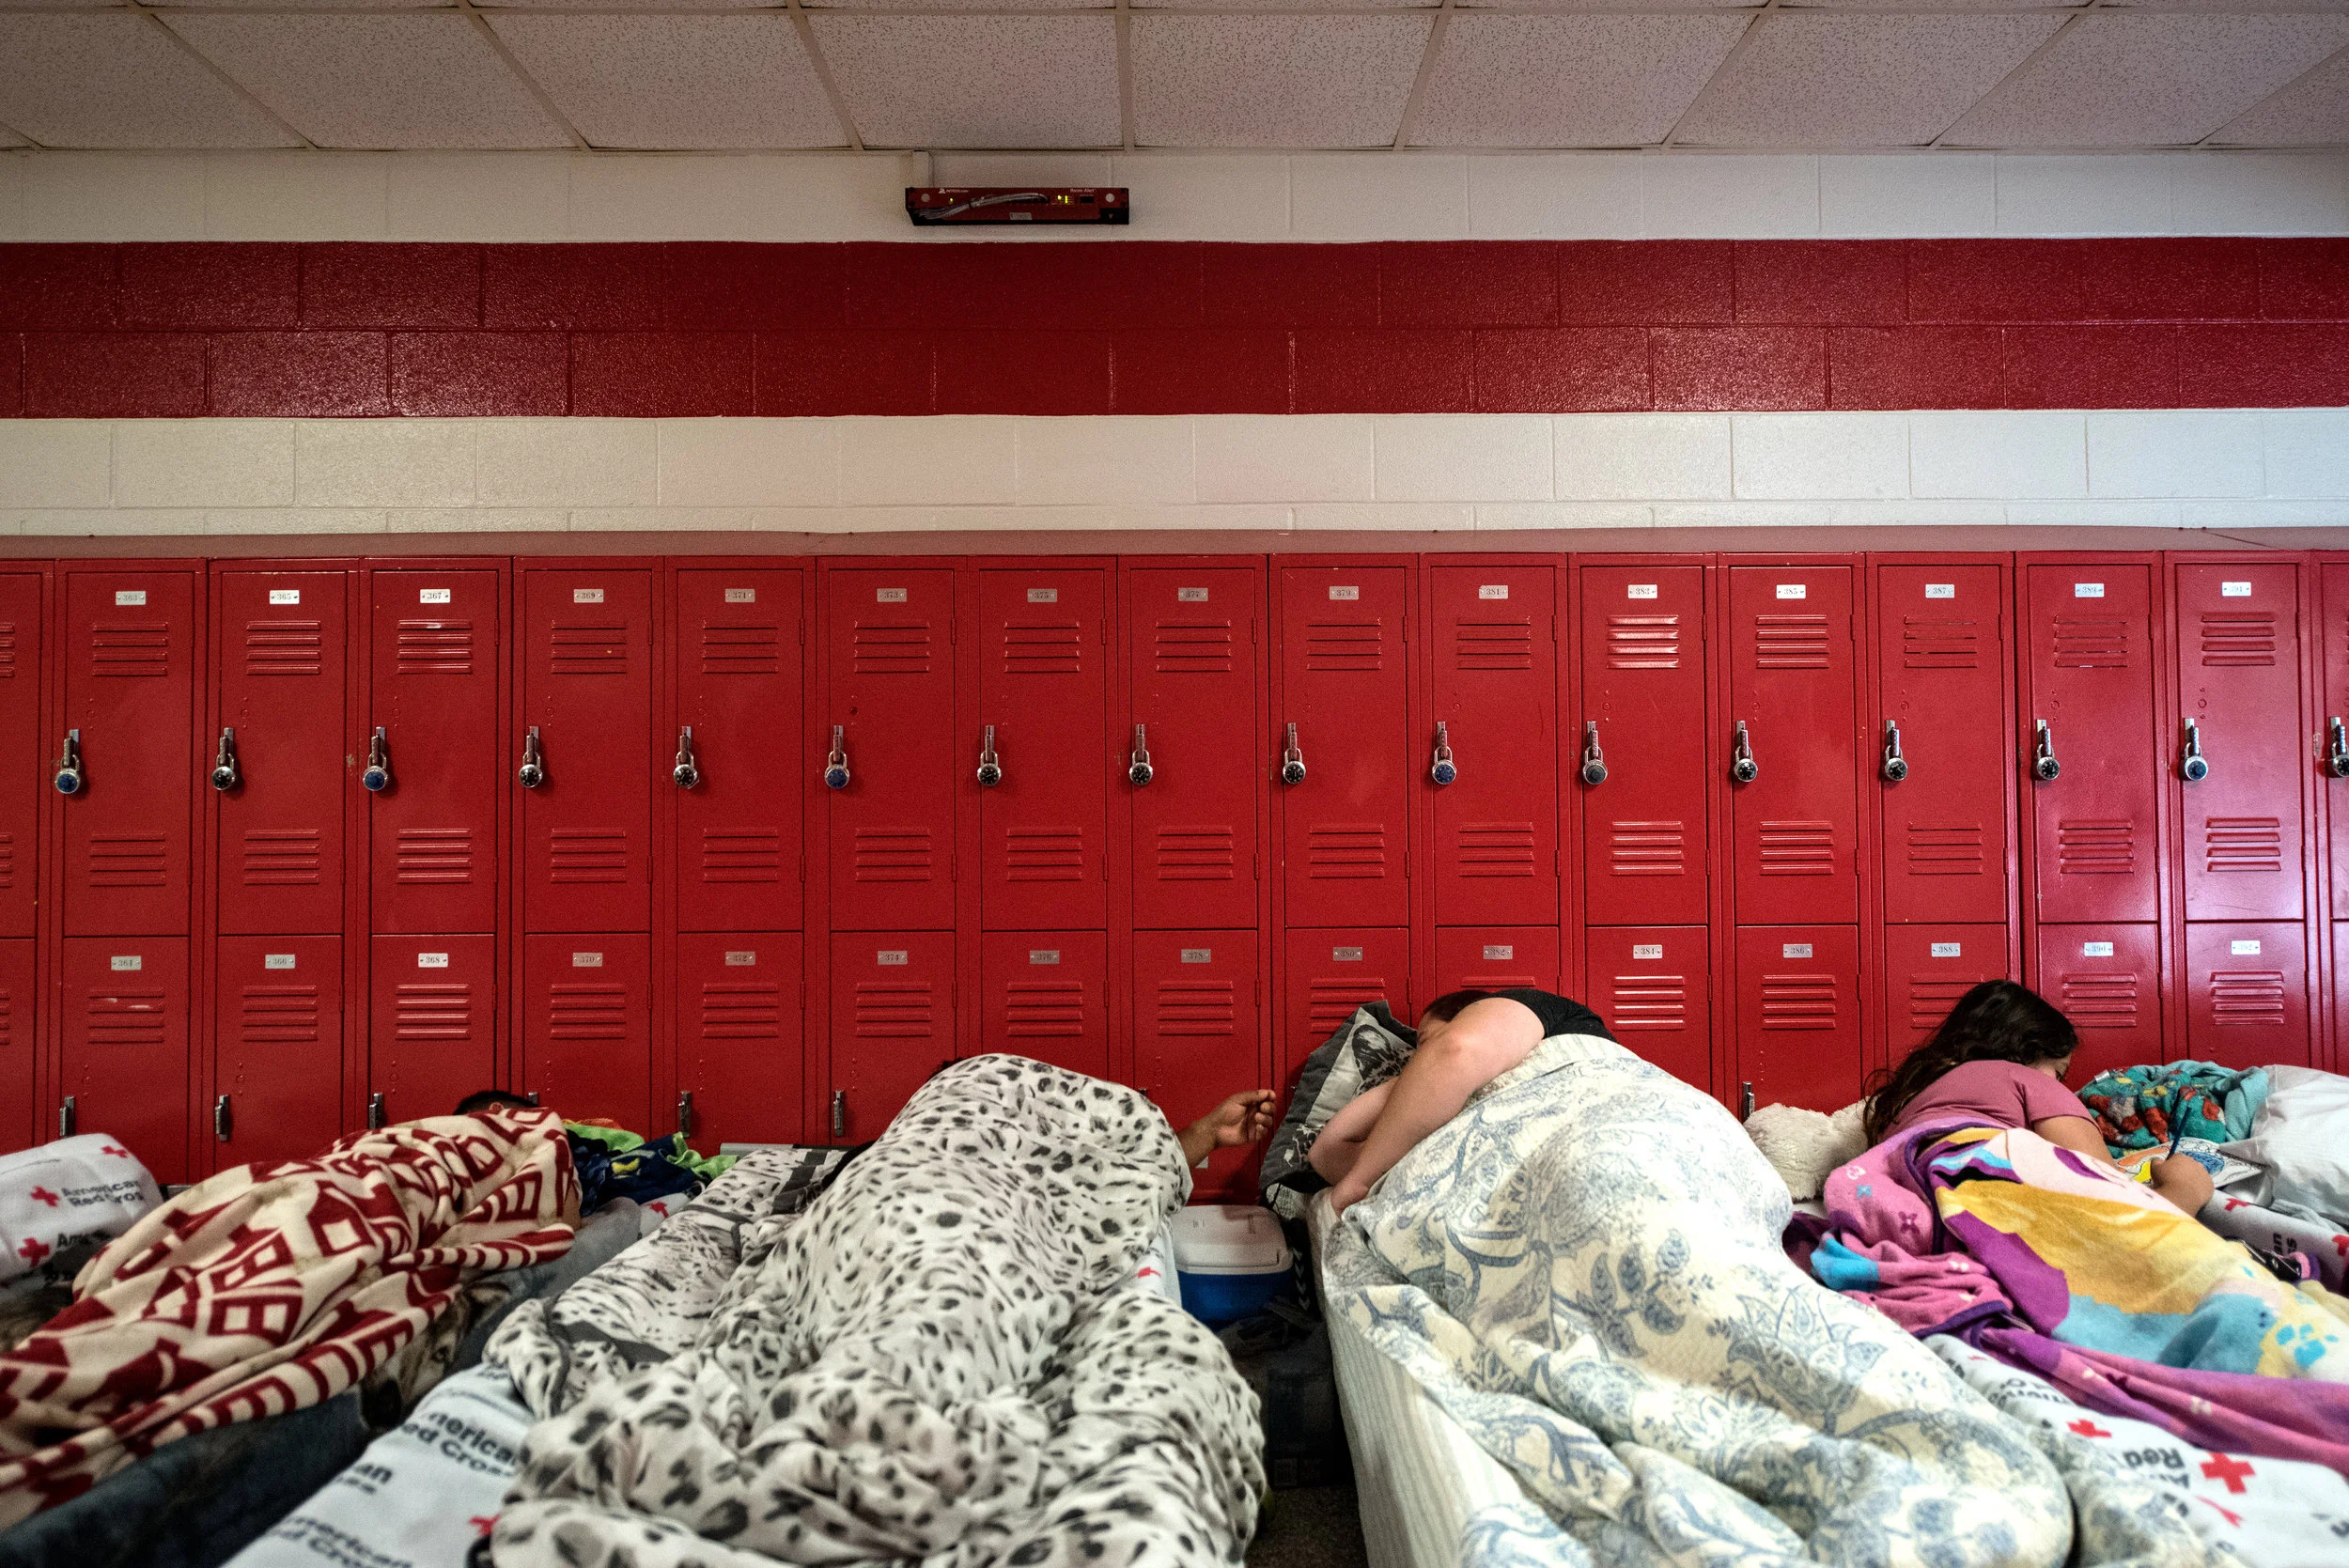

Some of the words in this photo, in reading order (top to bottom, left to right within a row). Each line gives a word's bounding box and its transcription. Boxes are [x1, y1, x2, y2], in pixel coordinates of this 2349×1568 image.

[68, 1191, 105, 1206] Red
[401, 1422, 439, 1444] ed
[2122, 1447, 2186, 1469] Red
